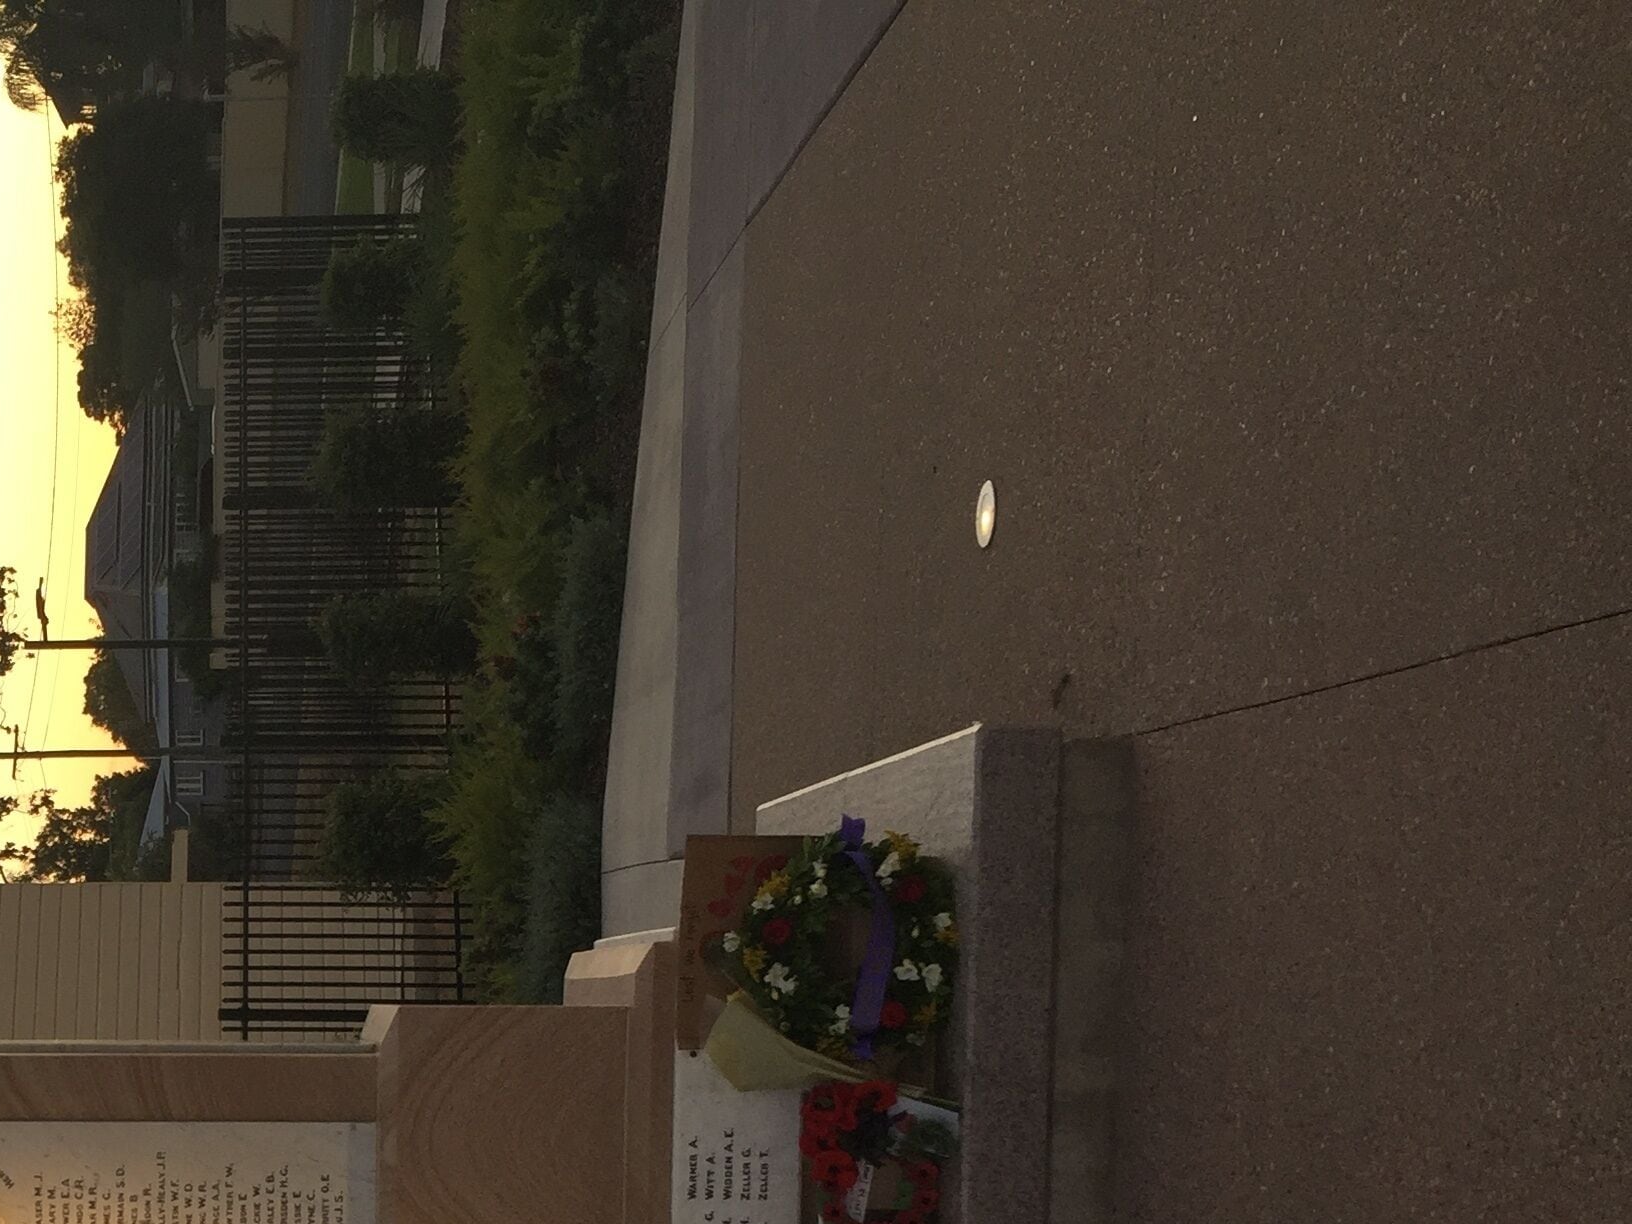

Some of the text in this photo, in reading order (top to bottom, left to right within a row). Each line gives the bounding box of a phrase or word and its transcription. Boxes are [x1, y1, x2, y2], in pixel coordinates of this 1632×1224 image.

[688, 1154, 698, 1200] WARNER
[705, 1170, 715, 1200] WITT
[741, 1162, 751, 1201] ZELLER
[759, 1163, 769, 1201] ZELLER
